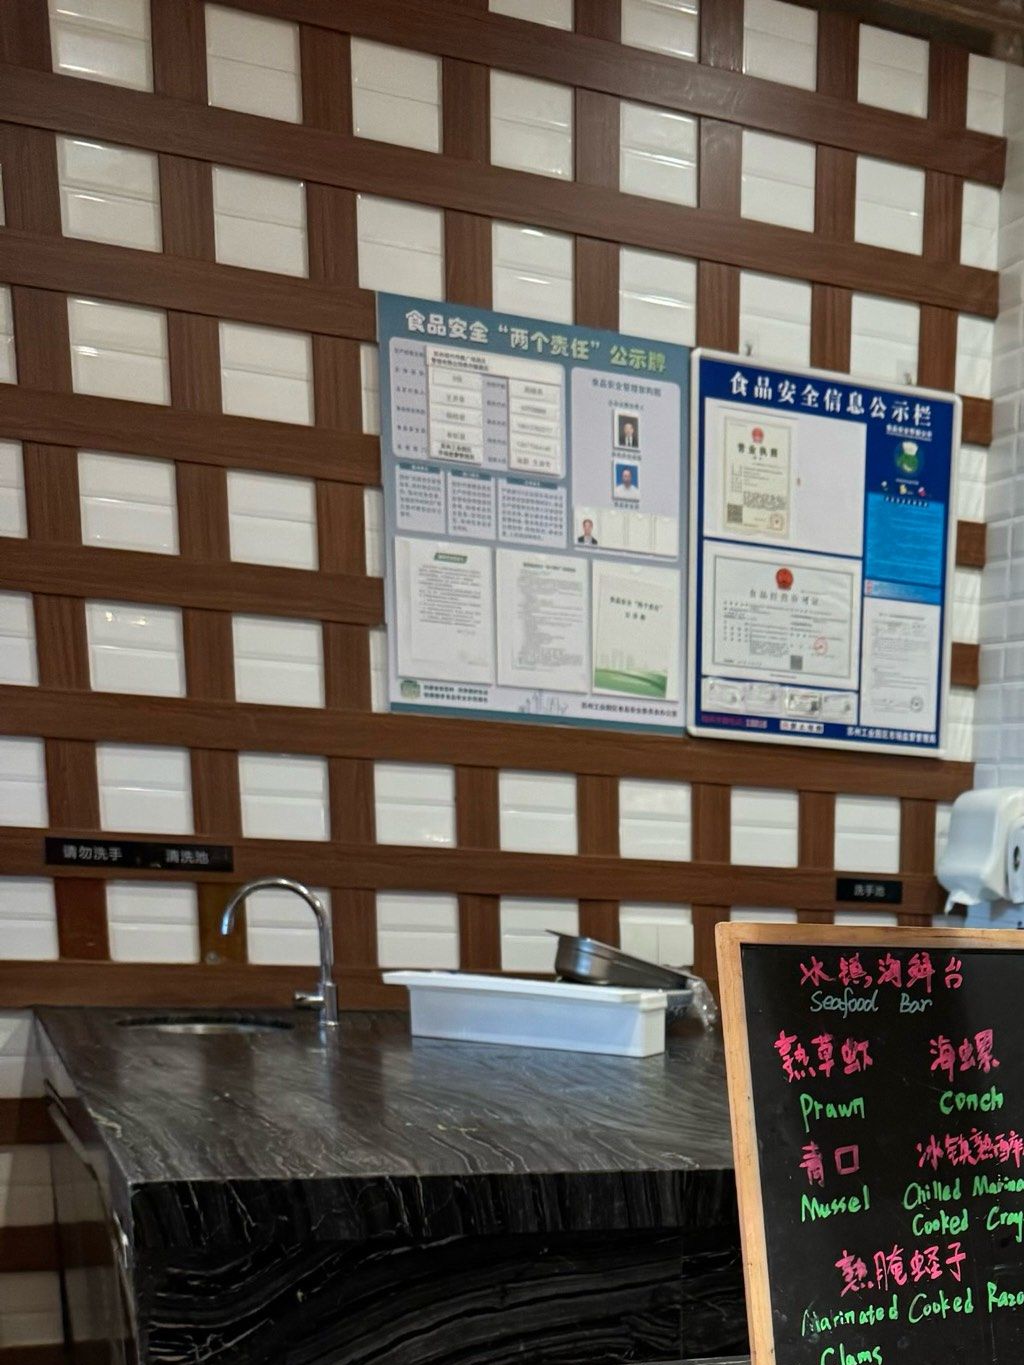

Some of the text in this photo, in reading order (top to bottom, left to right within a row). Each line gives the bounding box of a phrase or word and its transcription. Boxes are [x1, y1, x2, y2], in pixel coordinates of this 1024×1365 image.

[730, 371, 932, 427] 食品安全信息公示栏
[810, 987, 933, 1019] Seafood Bar
[799, 1093, 866, 1133] Prawn
[939, 1085, 1005, 1116] Conch
[799, 1140, 861, 1188] 青口
[801, 1184, 871, 1223] Mussel
[902, 1177, 962, 1211] Chilled
[912, 1208, 969, 1237] Cooked
[908, 1287, 974, 1325] Cooked
